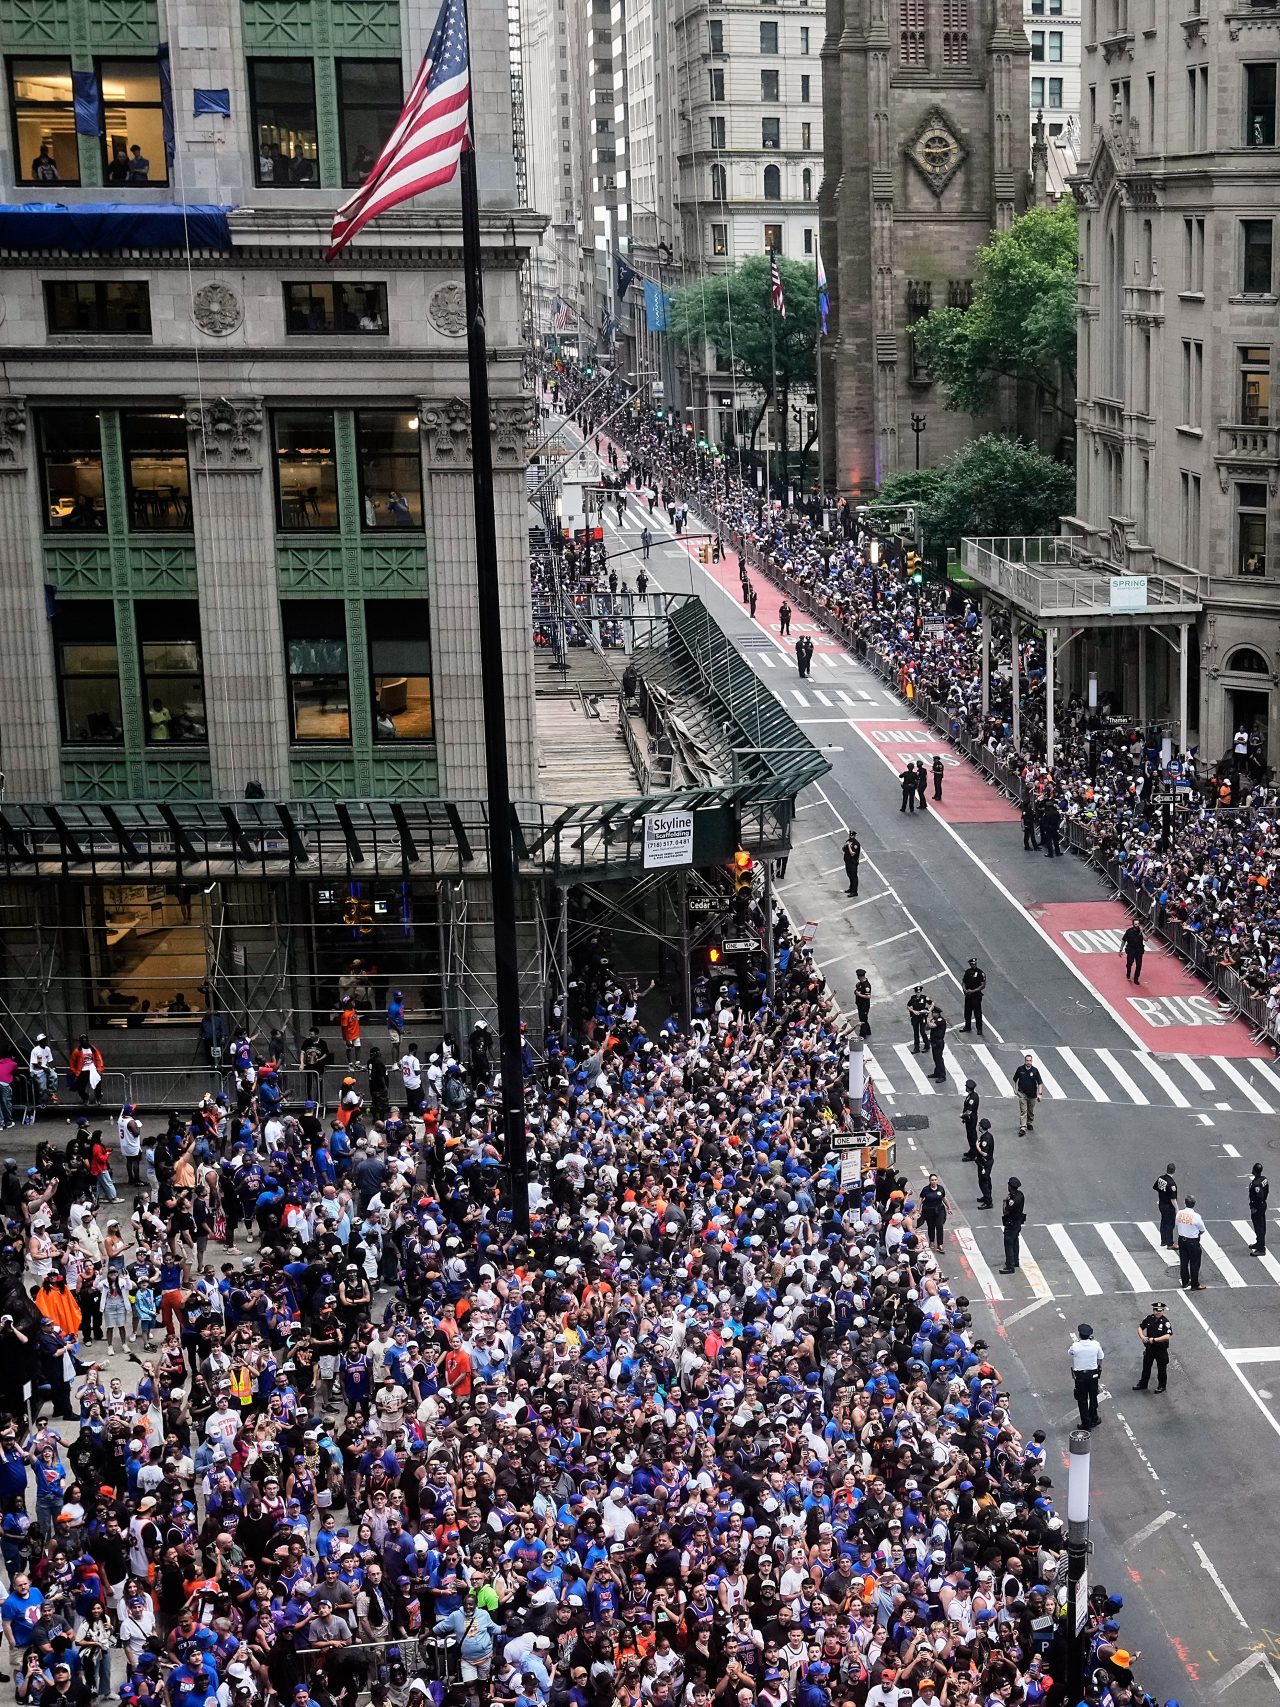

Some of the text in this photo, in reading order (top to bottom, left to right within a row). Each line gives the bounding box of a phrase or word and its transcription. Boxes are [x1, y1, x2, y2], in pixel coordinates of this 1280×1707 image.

[782, 636, 835, 646] BS
[871, 730, 937, 743] ONLY
[896, 753, 961, 767] BUS
[653, 816, 691, 832] Skyline
[655, 831, 690, 839] Scaffolding
[690, 901, 710, 909] Cedar
[1126, 995, 1228, 1028] BUS
[241, 1050, 248, 1060] 4
[119, 1129, 125, 1139] 3
[836, 1137, 851, 1145] ONE
[1041, 1641, 1049, 1653] P
